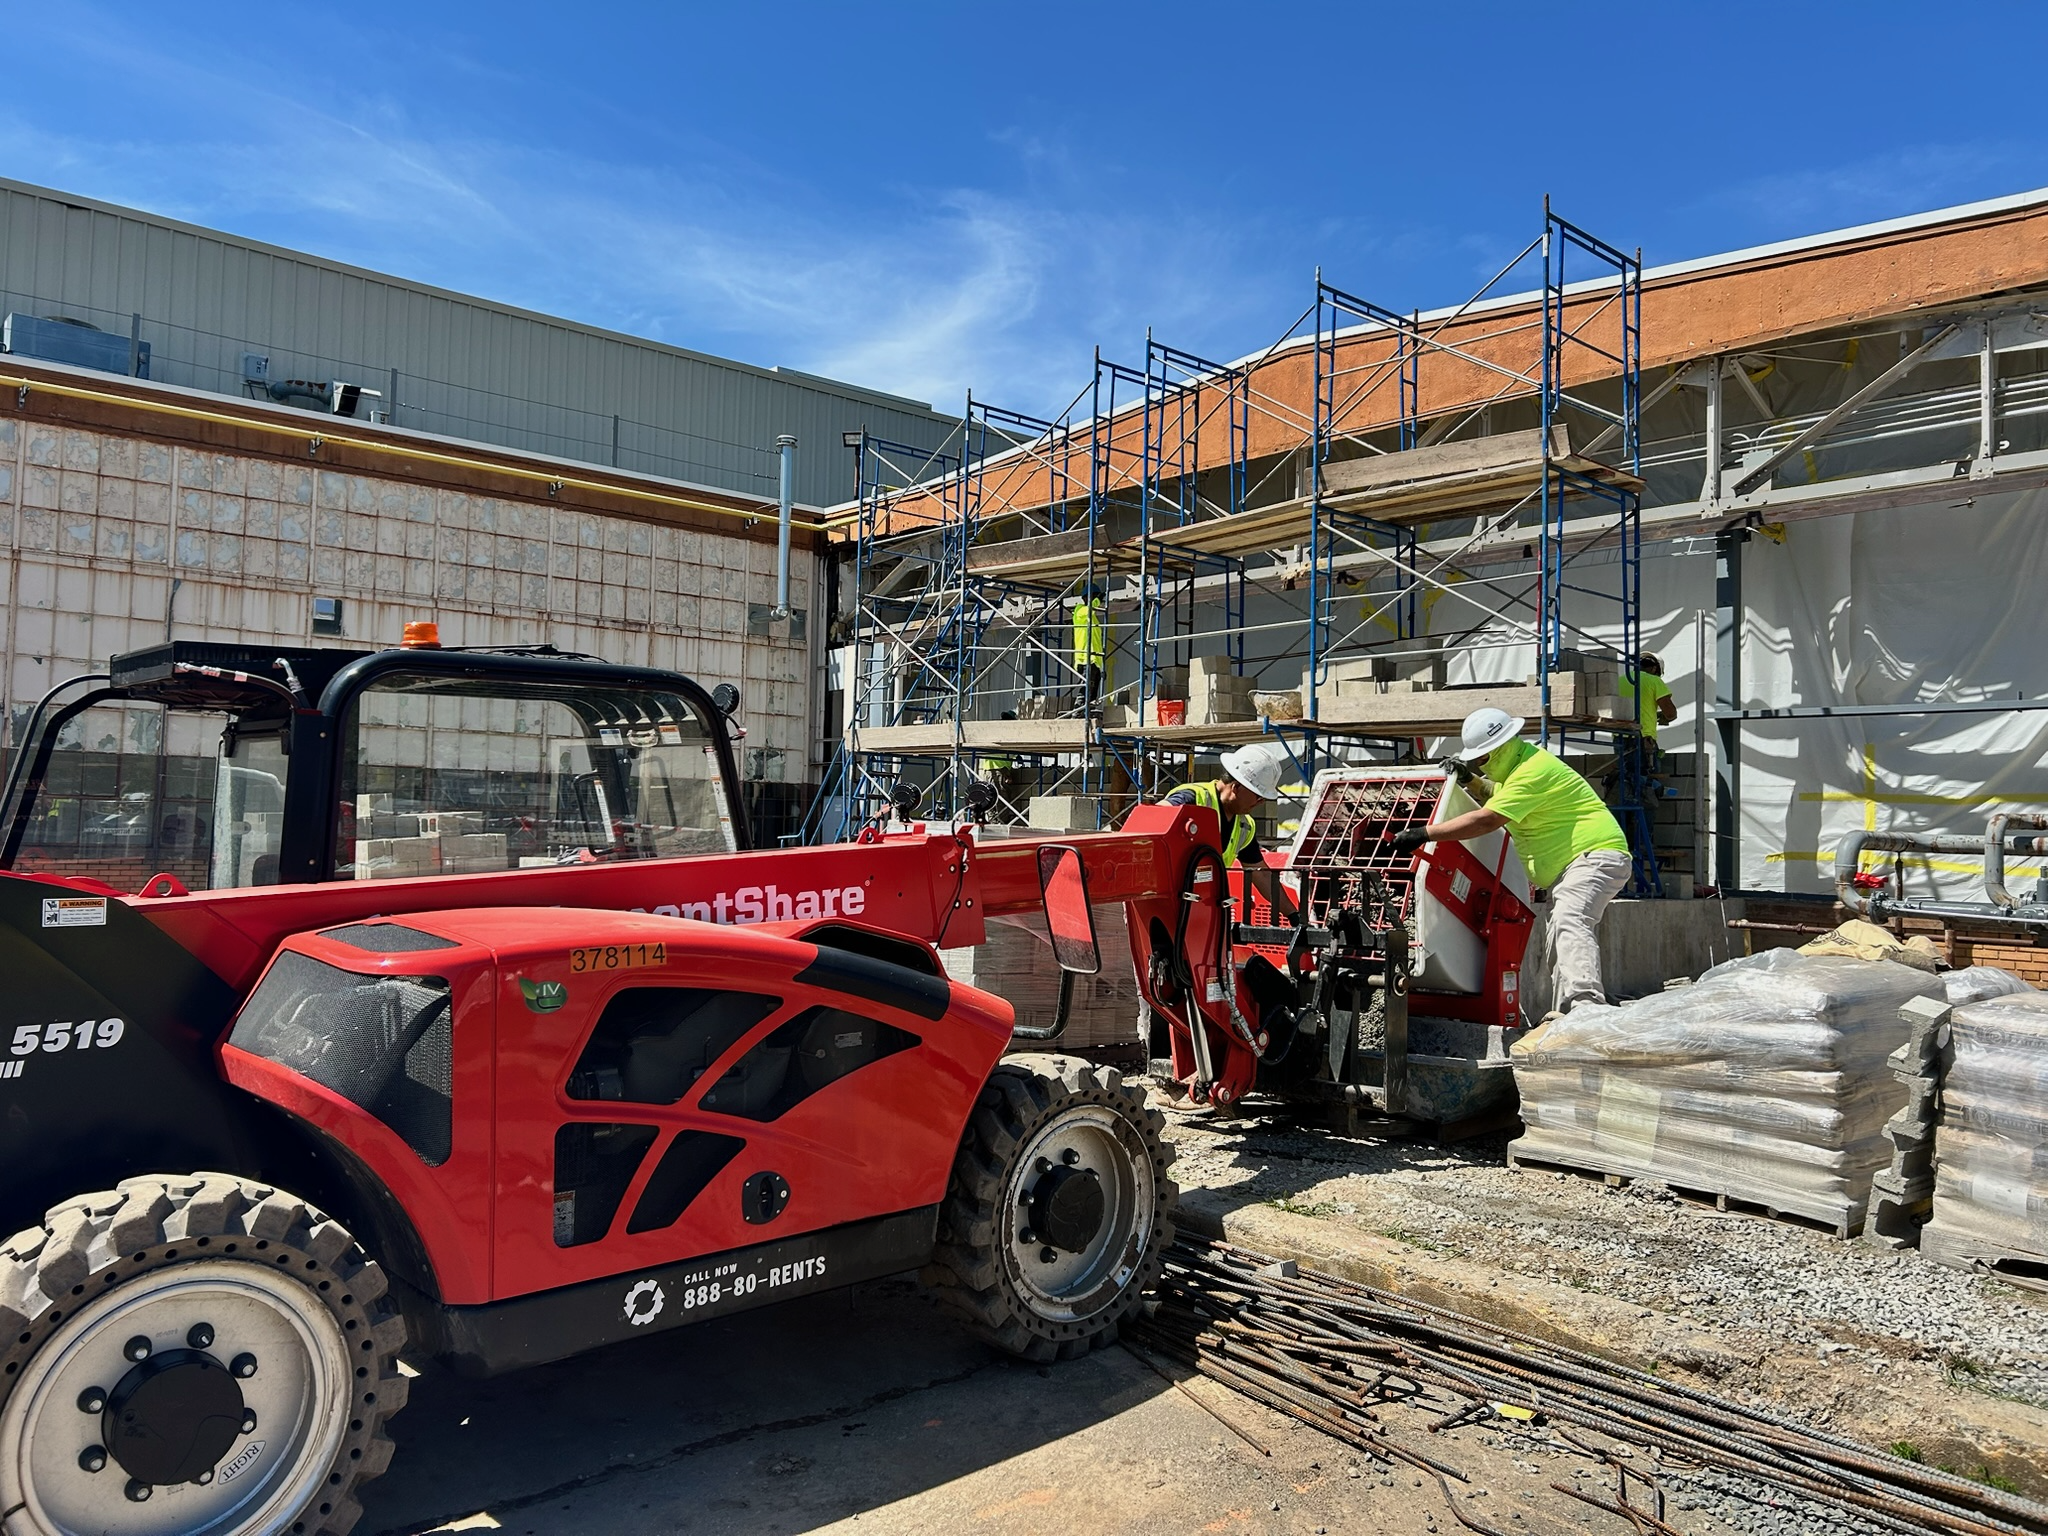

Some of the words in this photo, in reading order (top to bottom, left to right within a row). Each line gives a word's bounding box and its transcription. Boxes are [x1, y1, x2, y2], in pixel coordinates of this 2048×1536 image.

[572, 942, 665, 972] 378114
[542, 982, 562, 996] IV
[10, 1018, 125, 1056] 5519
[683, 1255, 827, 1310] 888-80-RENTS
[684, 1271, 711, 1285] CALL
[714, 1262, 738, 1278] NOW
[222, 1444, 260, 1481] RIGHT
